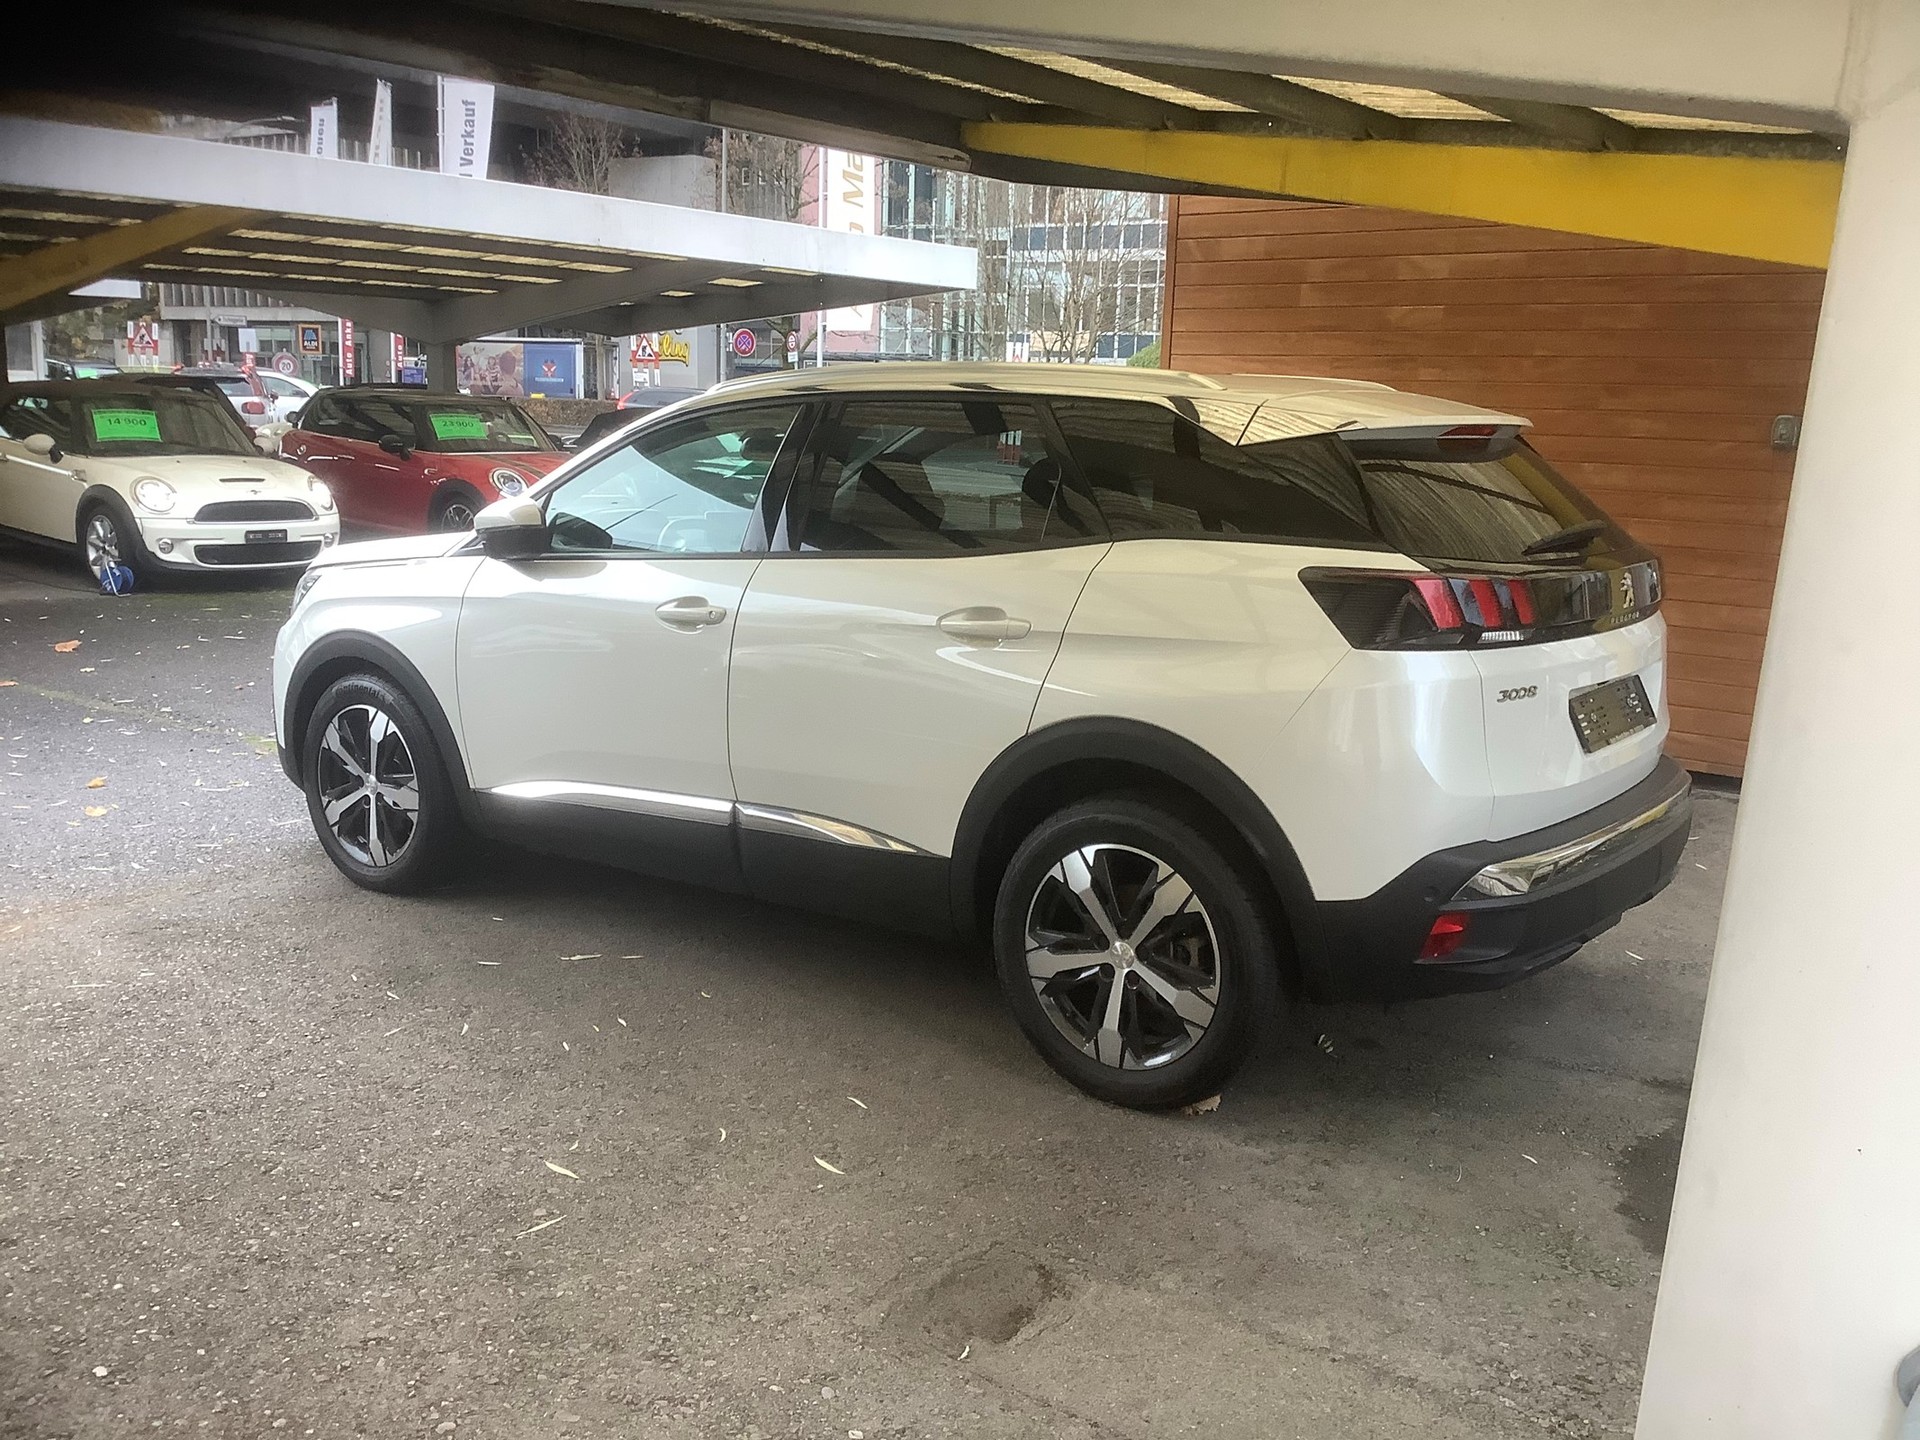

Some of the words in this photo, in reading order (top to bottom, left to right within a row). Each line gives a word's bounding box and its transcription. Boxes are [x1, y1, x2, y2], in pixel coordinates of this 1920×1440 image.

[460, 99, 476, 168] Verkauf
[281, 362, 291, 371] 20
[345, 352, 353, 375] Auto
[1496, 685, 1538, 703] 3008
